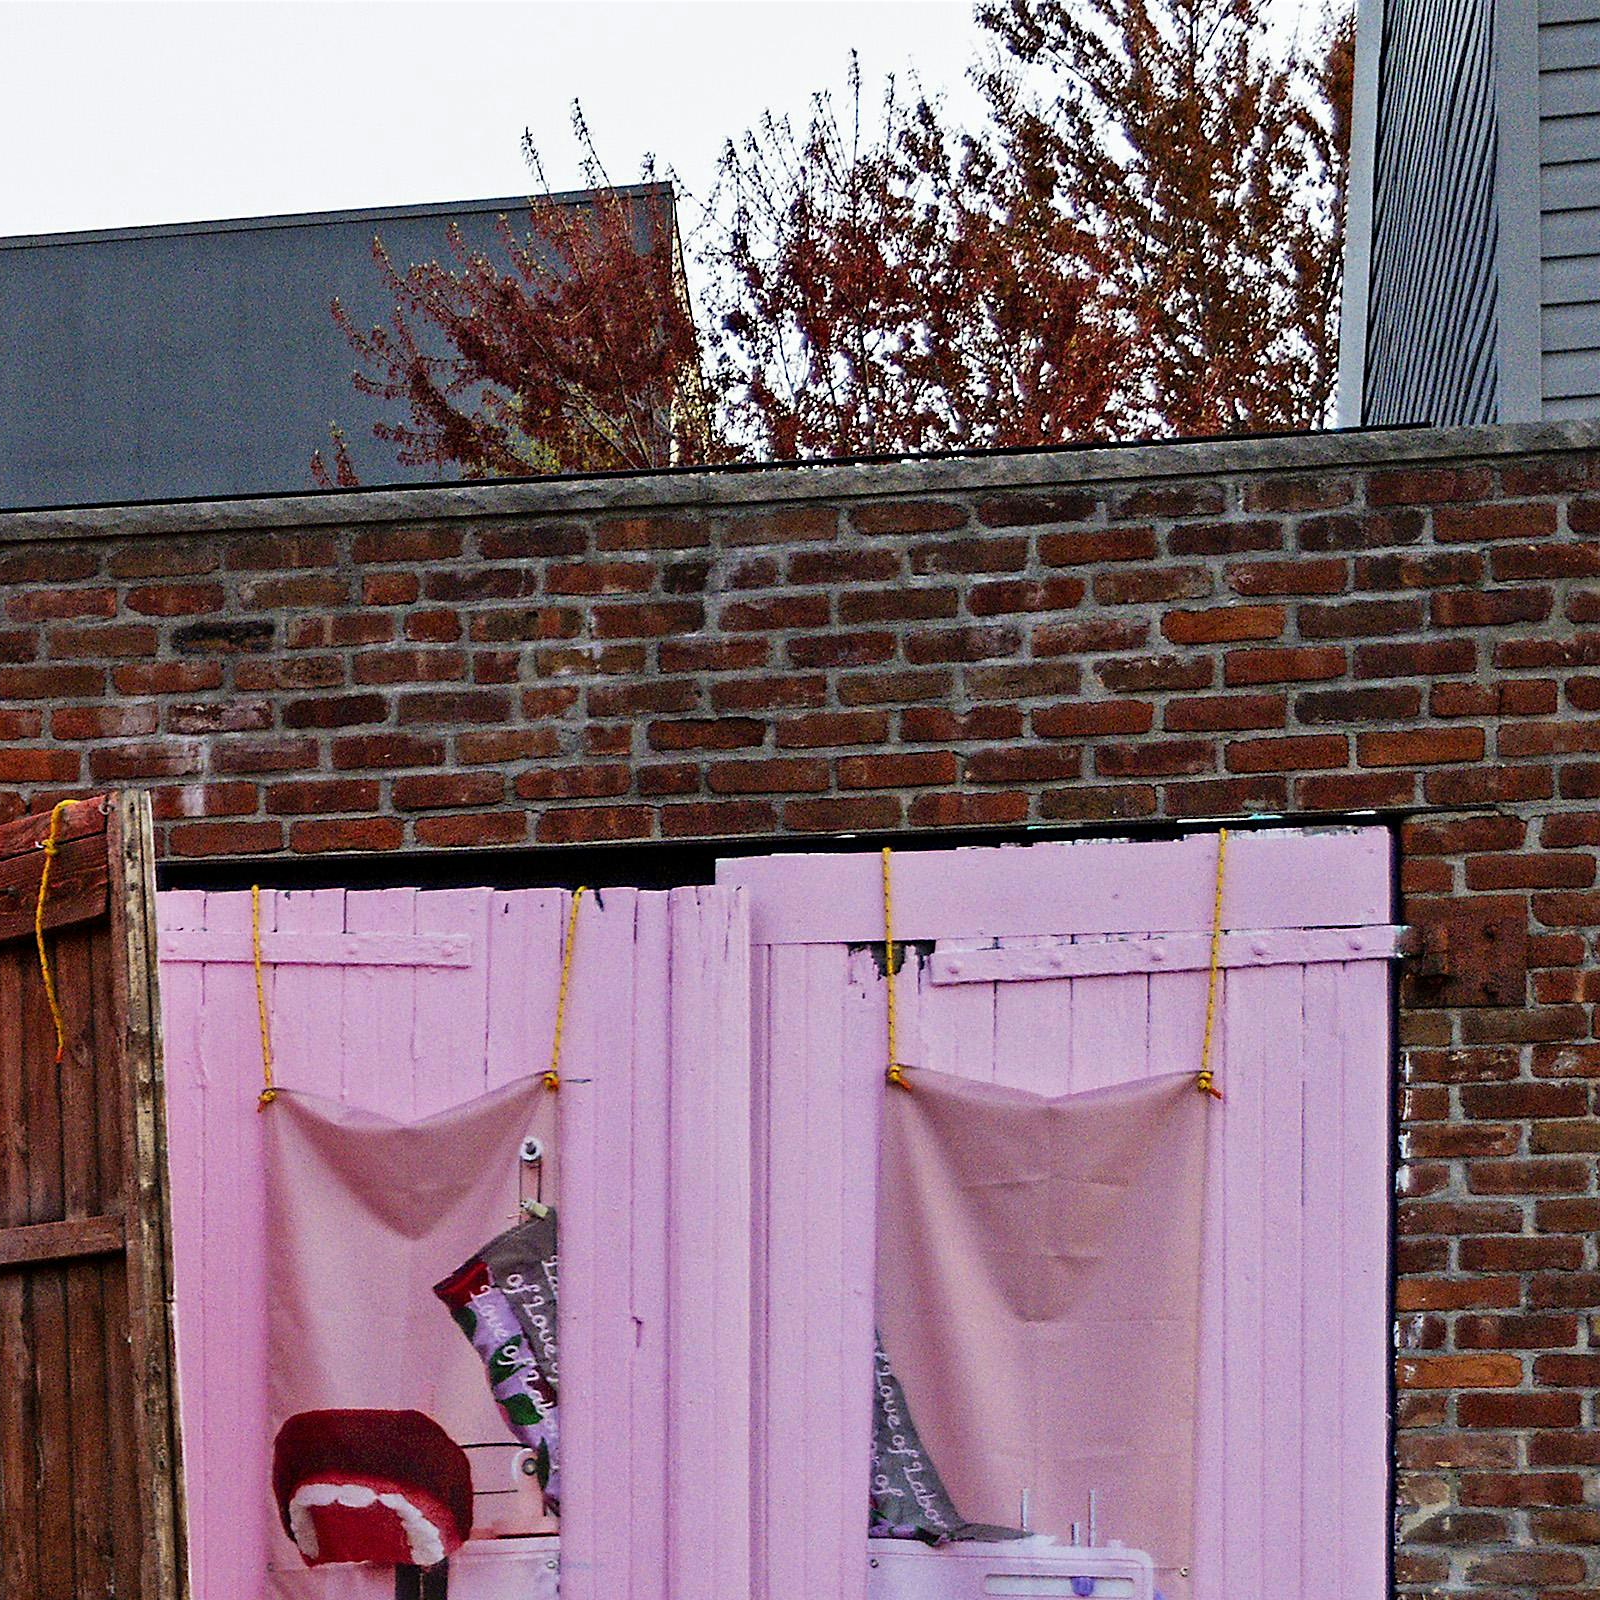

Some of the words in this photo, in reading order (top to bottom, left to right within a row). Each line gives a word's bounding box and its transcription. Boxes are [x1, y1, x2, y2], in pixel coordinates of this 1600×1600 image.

[468, 1285, 508, 1338] Love
[497, 1345, 538, 1371] of
[502, 1273, 541, 1294] of
[523, 1295, 558, 1359] Love
[876, 1365, 901, 1430] Love
[887, 1434, 920, 1459] of
[871, 1474, 904, 1498] of
[902, 1460, 949, 1529] Labor
